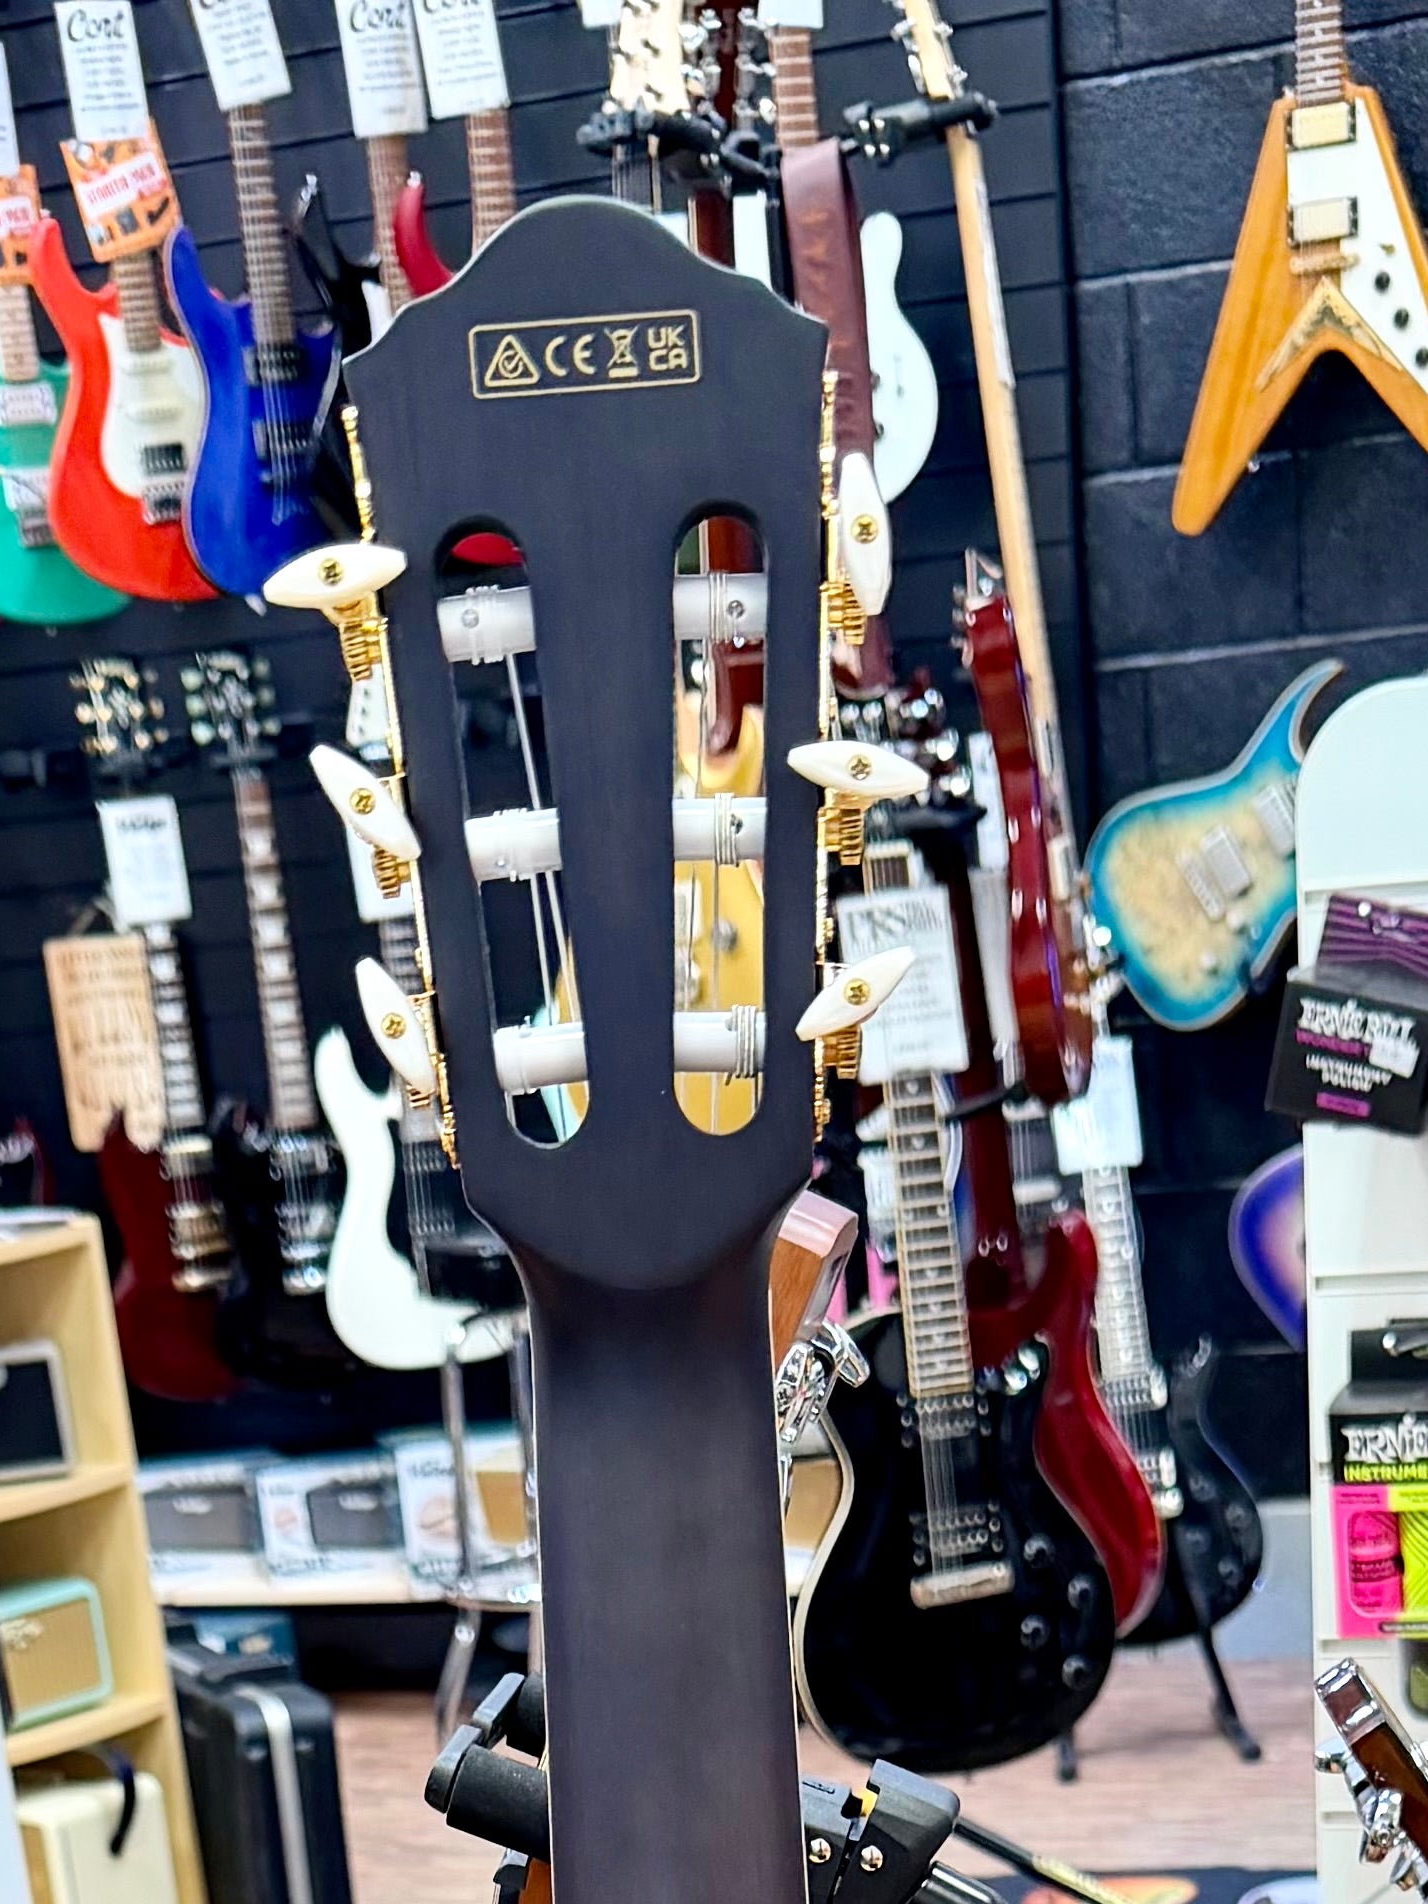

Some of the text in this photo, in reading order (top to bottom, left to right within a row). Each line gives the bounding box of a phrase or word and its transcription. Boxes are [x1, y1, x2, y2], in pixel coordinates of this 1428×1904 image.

[67, 8, 125, 43] Cort
[647, 325, 685, 350] UK
[543, 333, 596, 377] CE
[649, 348, 687, 372] CA
